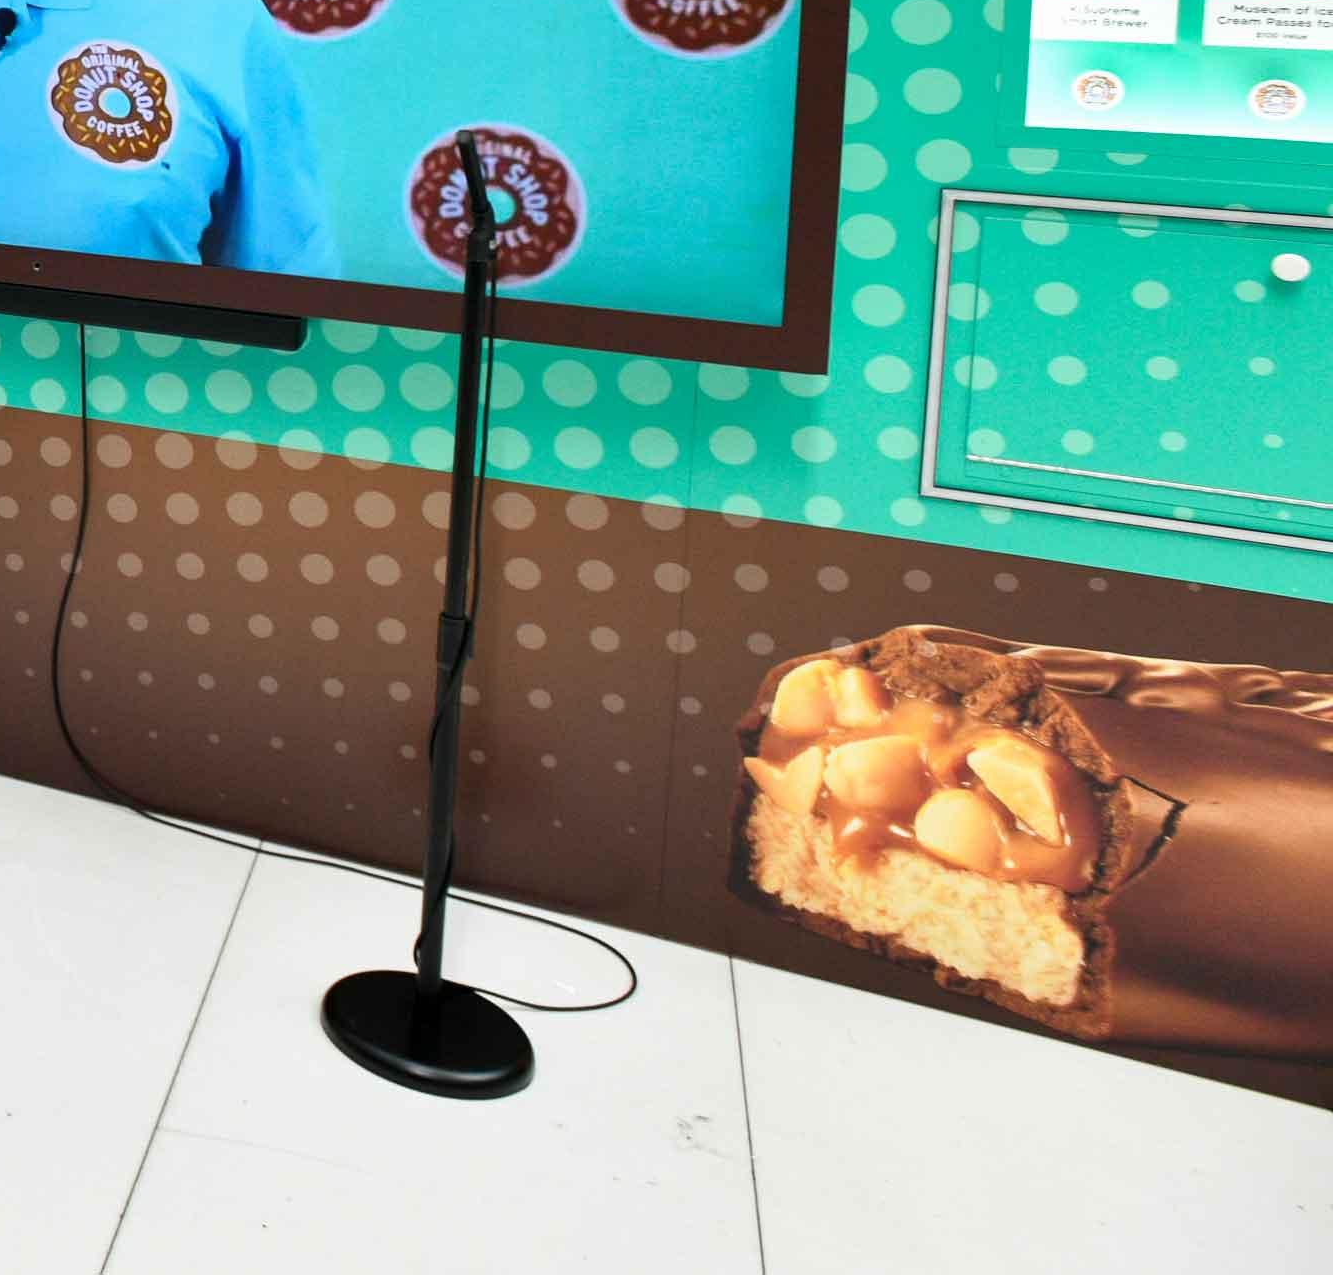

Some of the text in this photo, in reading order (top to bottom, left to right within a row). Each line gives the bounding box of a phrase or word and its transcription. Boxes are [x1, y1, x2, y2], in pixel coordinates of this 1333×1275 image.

[1234, 4, 1291, 14] Museum
[1295, 6, 1310, 15] of
[1102, 18, 1148, 28] Brewer
[1217, 16, 1261, 25] Cream
[1266, 18, 1312, 28] Passes
[81, 54, 141, 74] ORIGINAL
[74, 66, 155, 122] DONUT SHOP
[86, 115, 144, 138] COFFEE
[502, 163, 550, 226] SHOP
